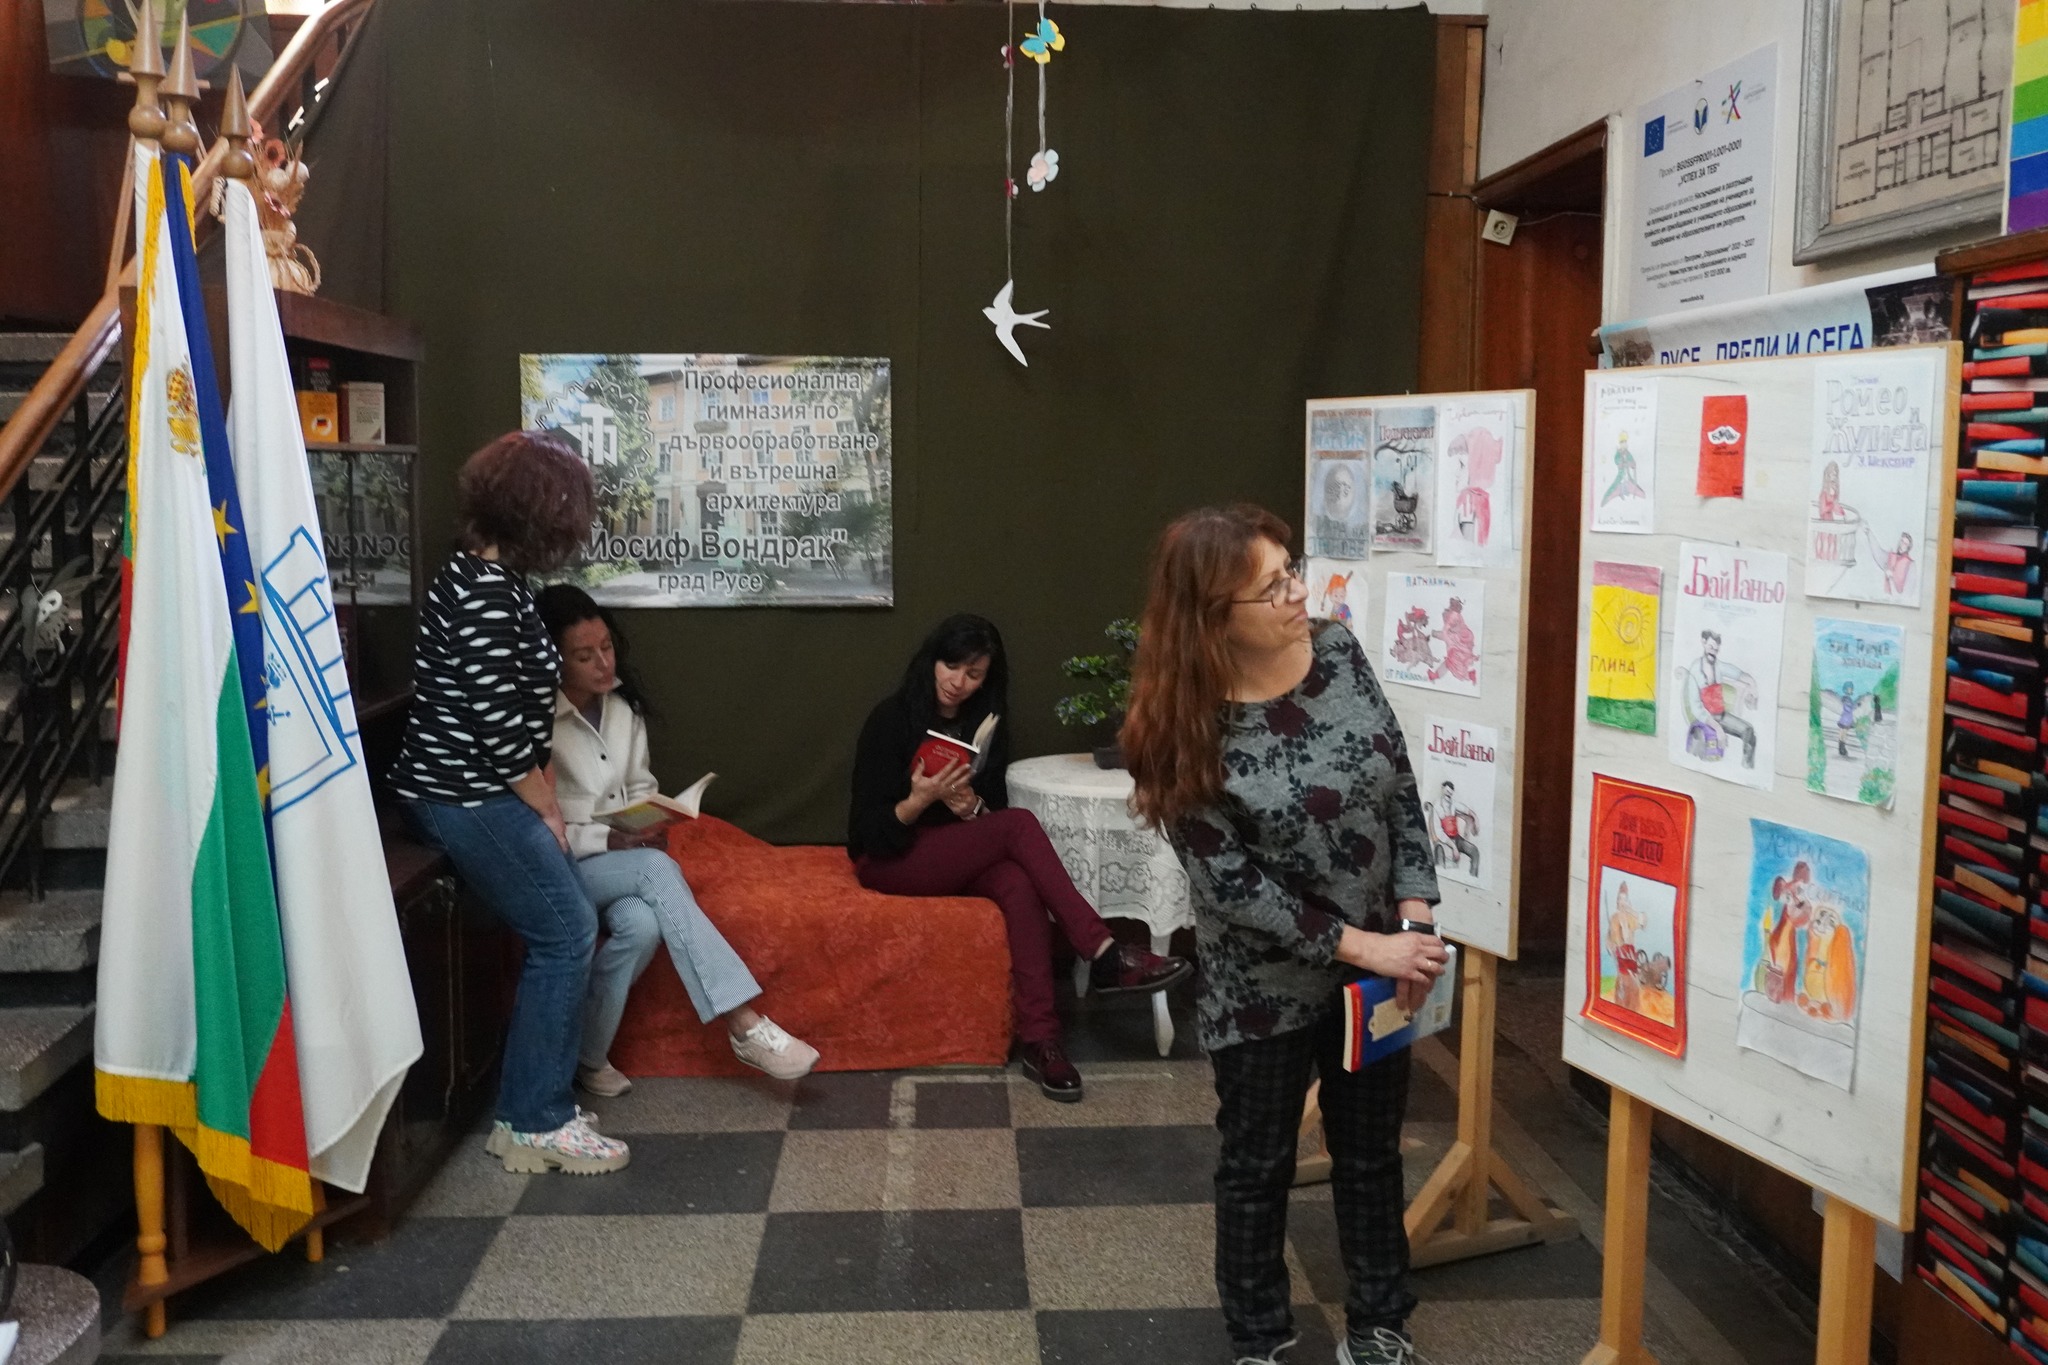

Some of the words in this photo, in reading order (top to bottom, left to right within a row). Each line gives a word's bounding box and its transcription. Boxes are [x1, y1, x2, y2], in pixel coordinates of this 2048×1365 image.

[1787, 332, 1799, 355] И
[1807, 323, 1864, 353] СЕГА
[684, 370, 861, 394] Професионална
[707, 402, 807, 421] гимназия
[814, 404, 839, 421] по
[669, 433, 879, 455] дървообработване
[711, 465, 722, 479] и
[730, 464, 837, 480] вътрешна
[707, 494, 840, 515] архитектура
[658, 573, 705, 593] град
[711, 571, 763, 593] Русе
[1684, 556, 1730, 601] Бай
[1731, 559, 1785, 603] Ганьо
[1590, 655, 1636, 677] ГЛИНА
[1459, 728, 1496, 764] Ганьо
